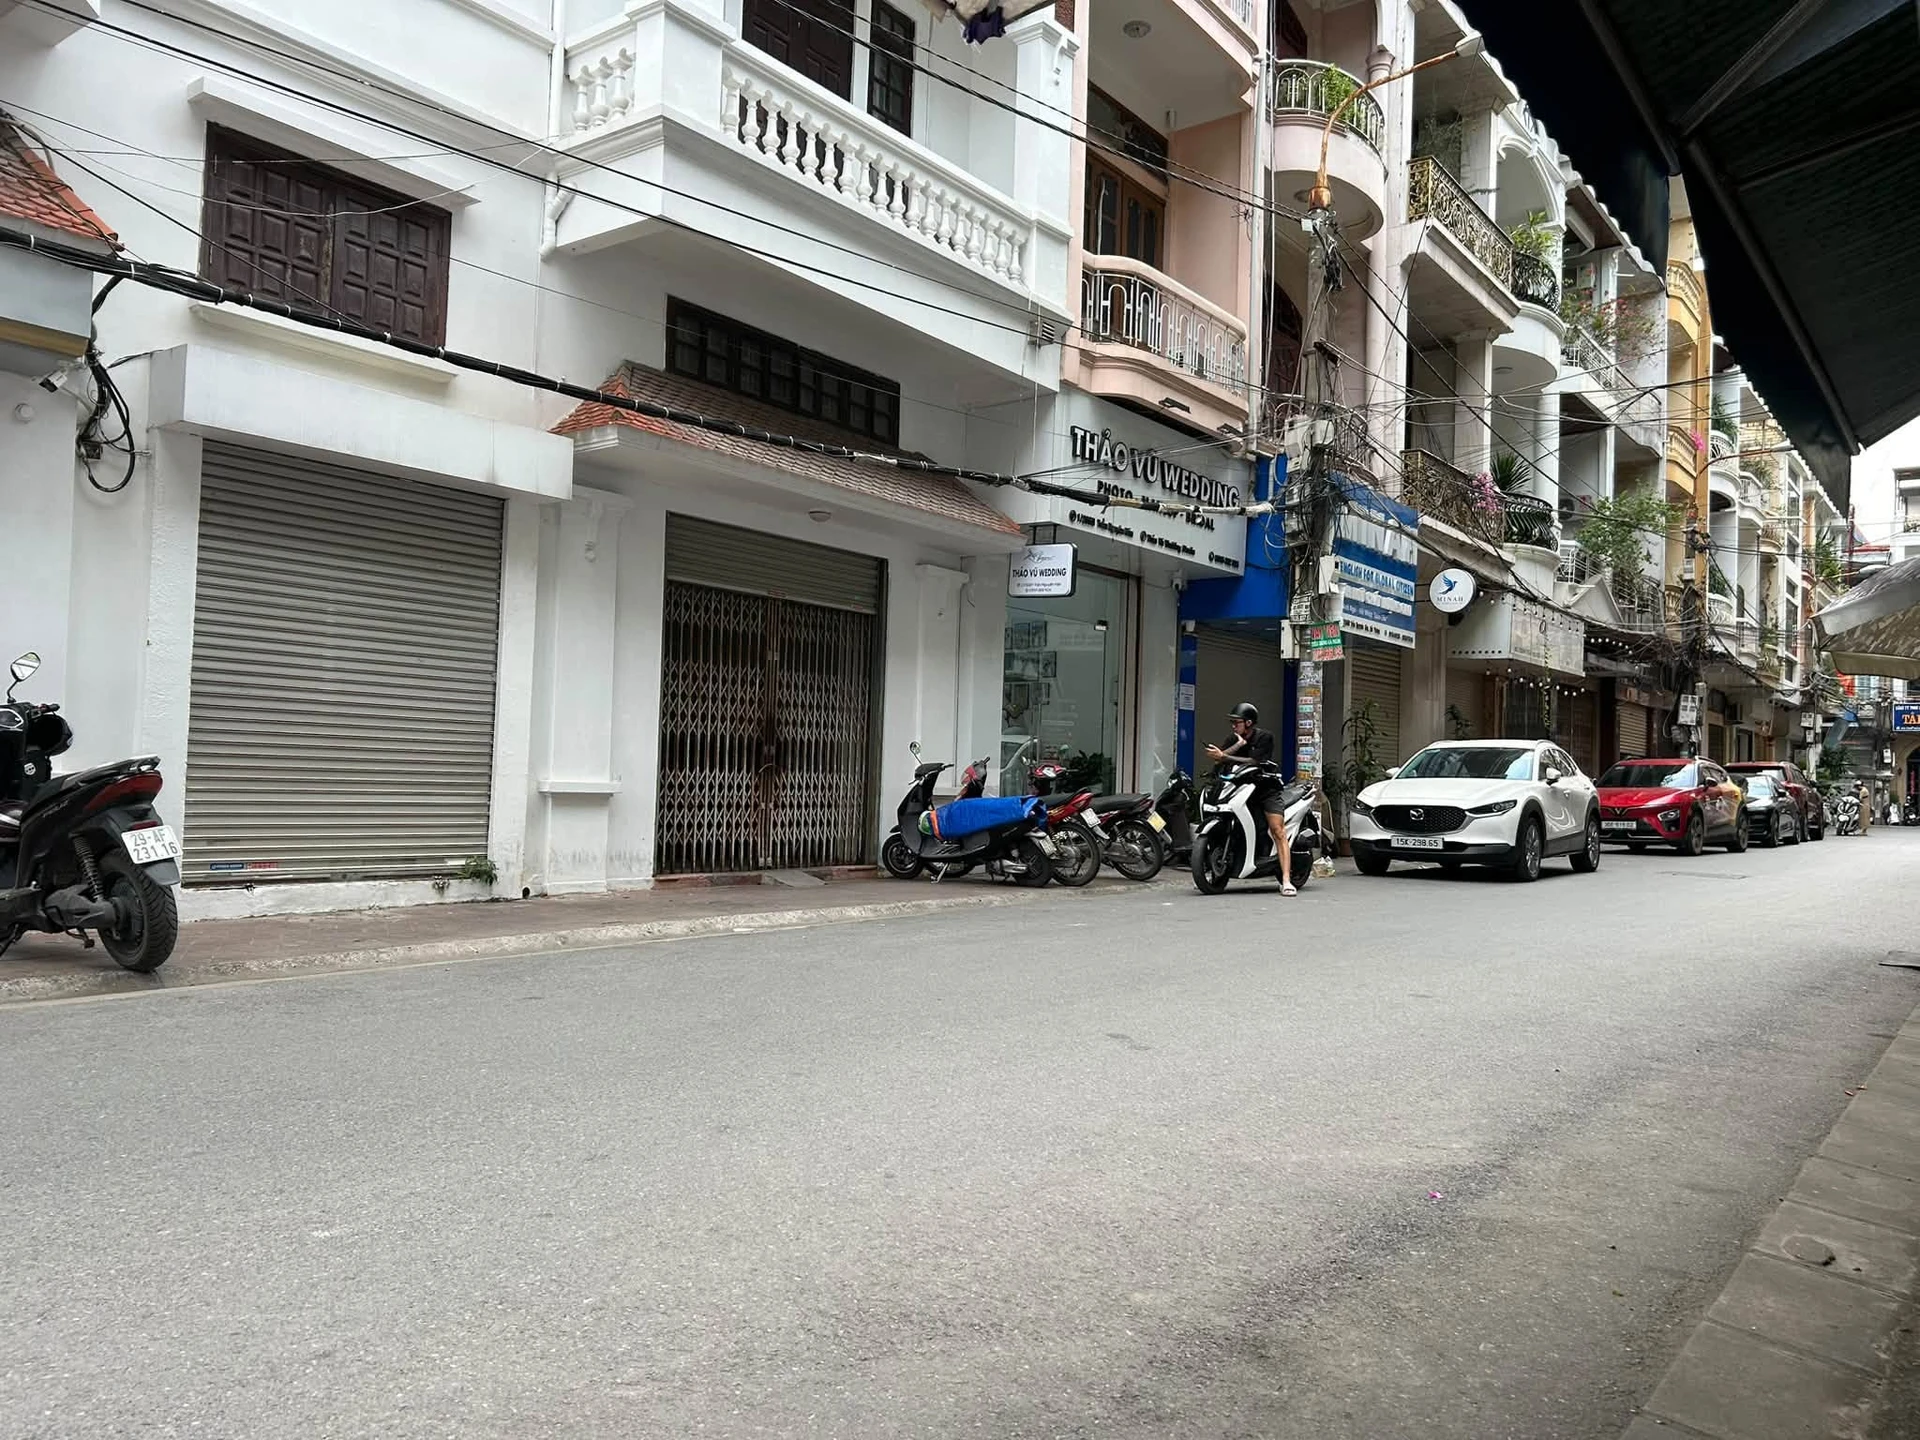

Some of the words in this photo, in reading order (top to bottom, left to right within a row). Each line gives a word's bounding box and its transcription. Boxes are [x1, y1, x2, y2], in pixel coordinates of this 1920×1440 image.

[1071, 426, 1128, 472] THẢO
[1160, 460, 1240, 508] WEDDING
[1012, 566, 1029, 578] THẢO
[1039, 567, 1067, 577] WEDDING
[1340, 561, 1363, 578] ENGLISH
[1364, 568, 1374, 582] FOR
[1375, 573, 1395, 589] GLOBAL
[1396, 580, 1414, 596] CITIZEN
[131, 829, 166, 847] 29-AF
[1396, 837, 1439, 848] 15K-298.65
[133, 842, 178, 861] 231.16
